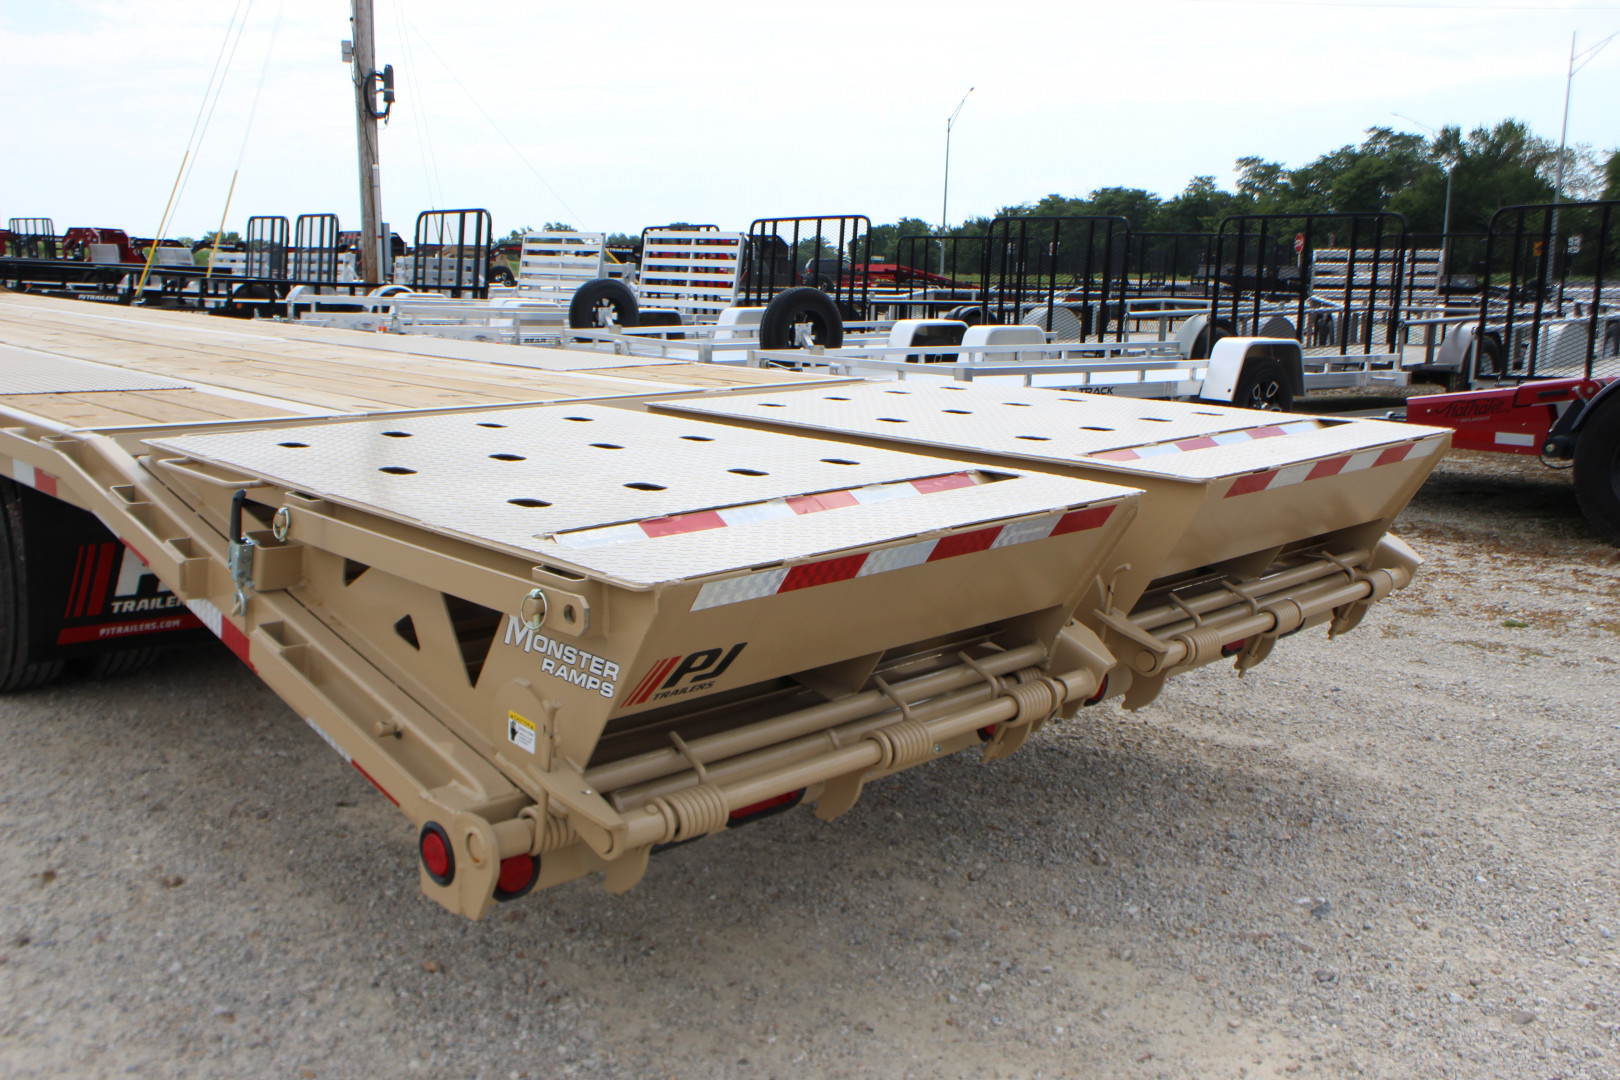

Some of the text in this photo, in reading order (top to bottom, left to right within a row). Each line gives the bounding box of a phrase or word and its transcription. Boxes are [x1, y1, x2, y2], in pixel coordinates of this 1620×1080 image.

[541, 657, 615, 698] RAMPS
[661, 641, 748, 690] PJ
[653, 681, 716, 701] TRAILERS
